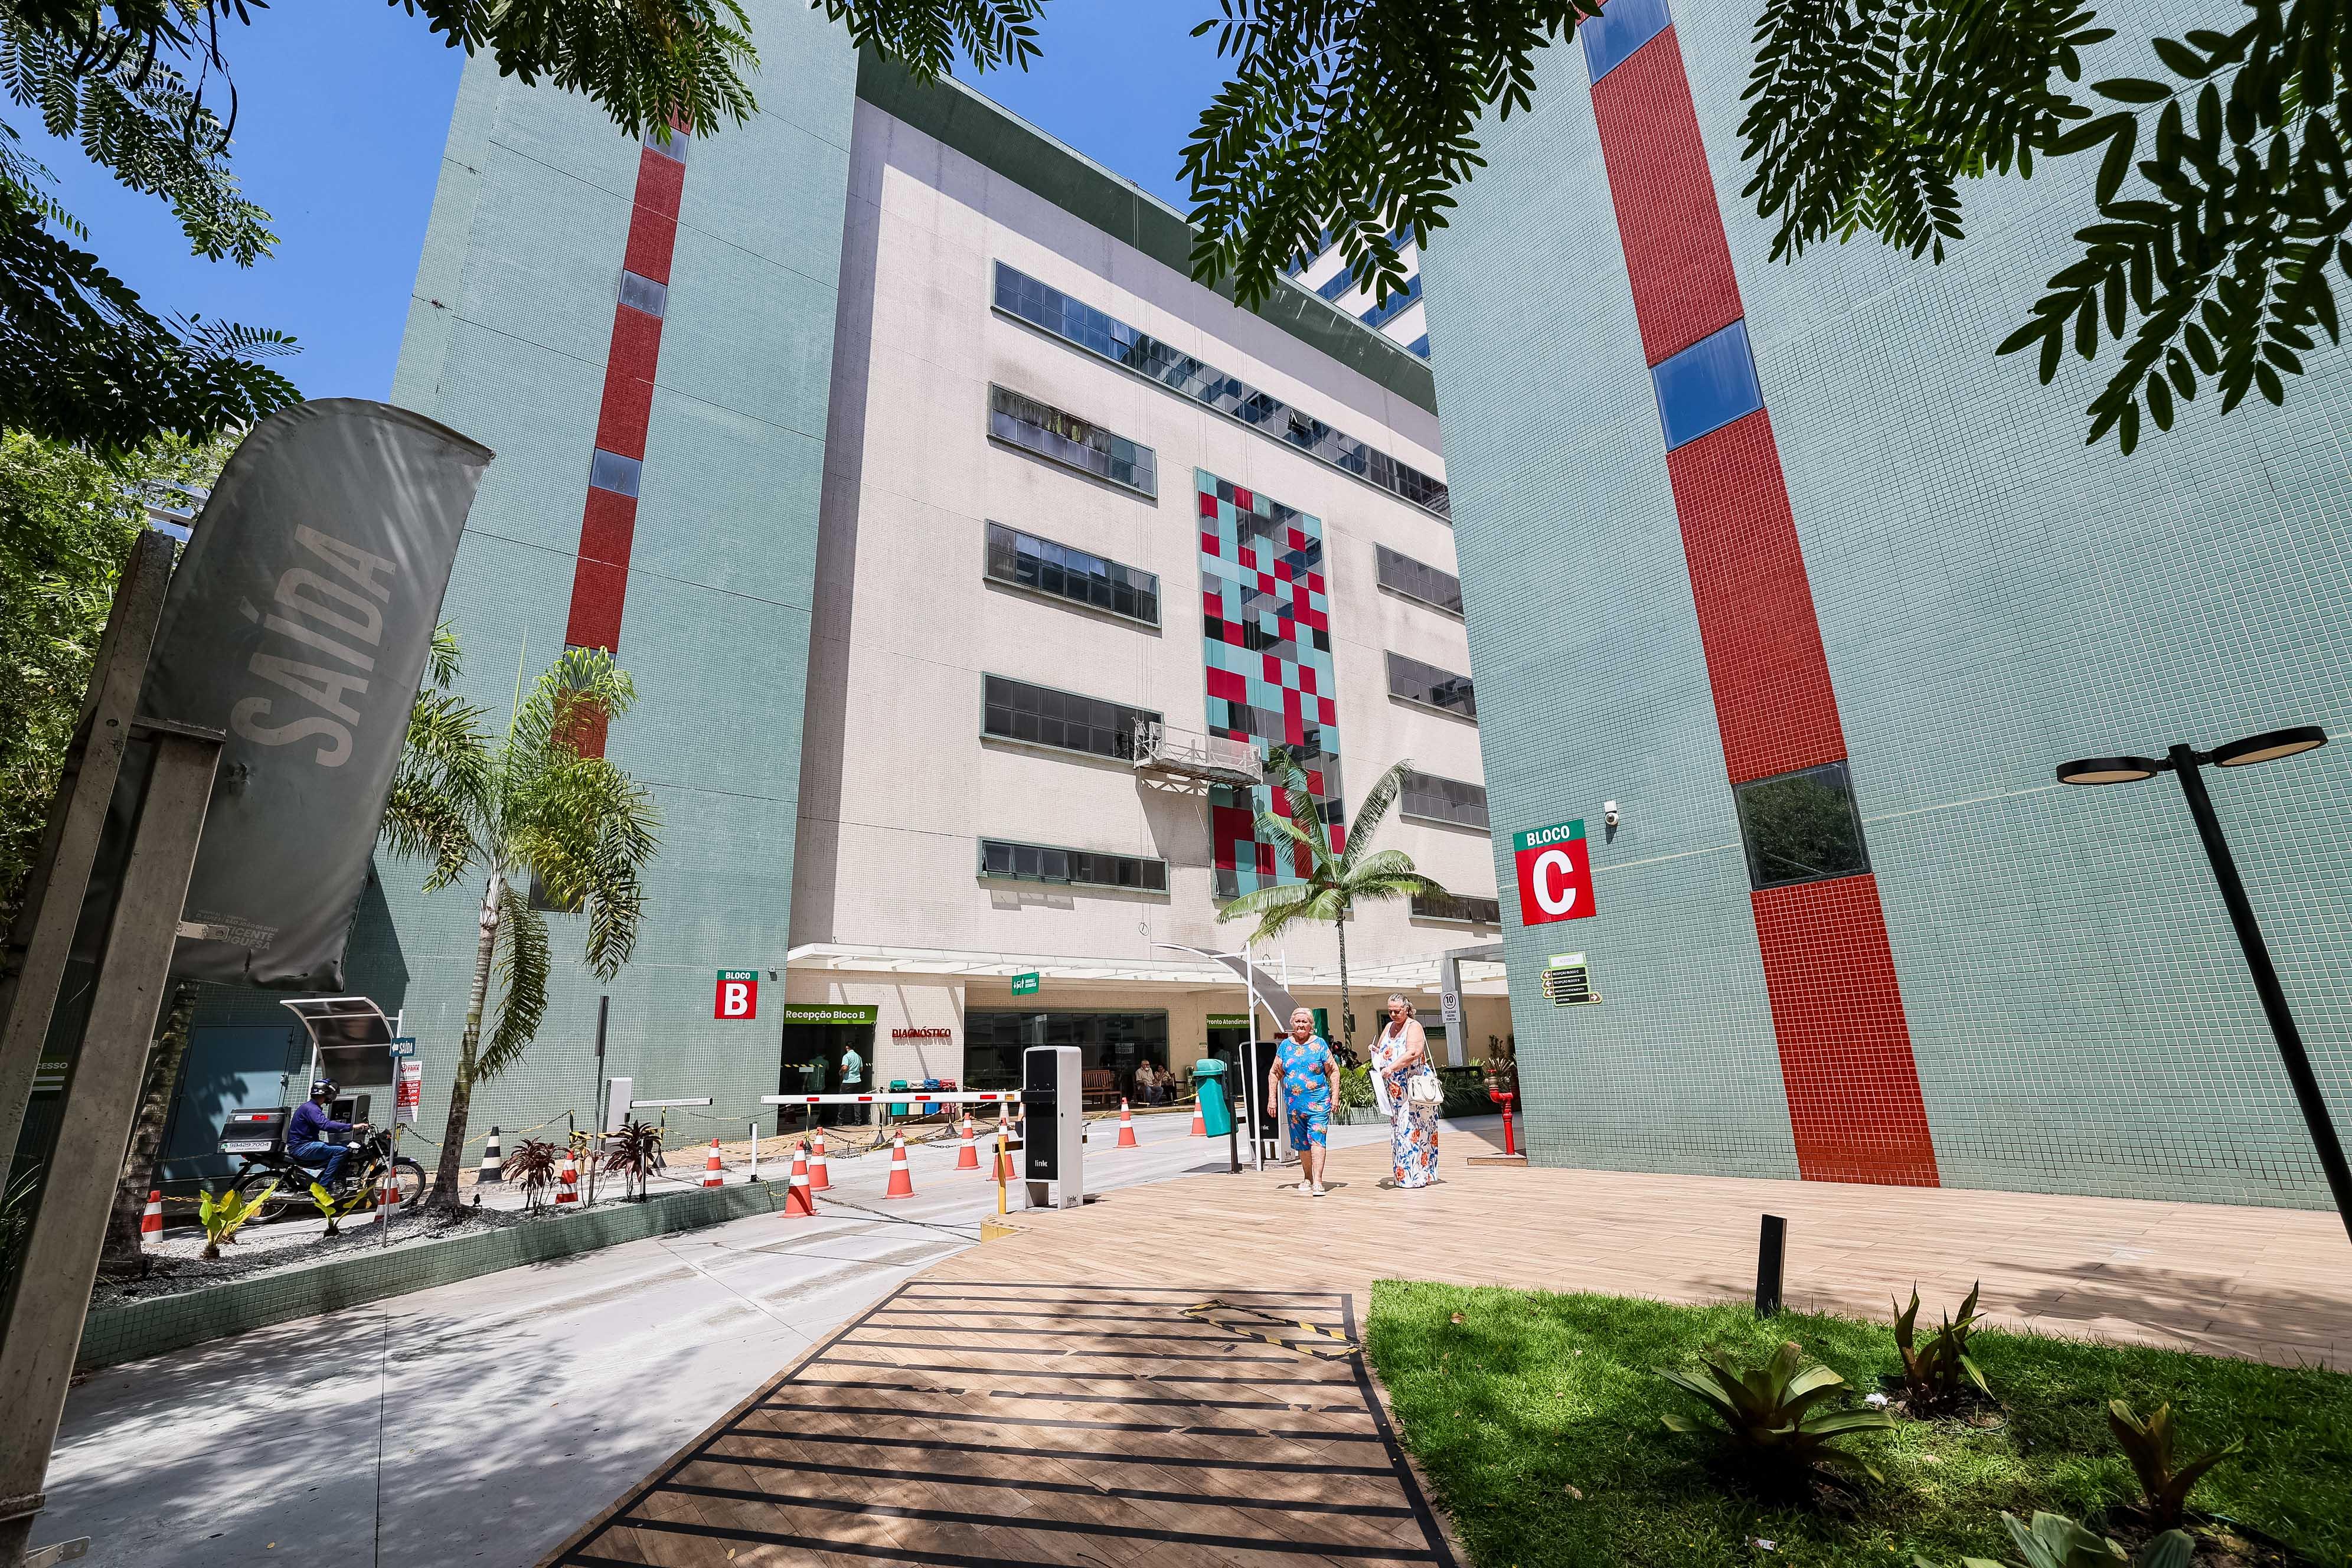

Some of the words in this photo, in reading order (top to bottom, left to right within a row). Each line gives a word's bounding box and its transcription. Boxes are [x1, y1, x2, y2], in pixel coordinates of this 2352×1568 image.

[231, 524, 397, 767] SAÍDA
[1526, 825, 1570, 847] BLOCO
[1533, 850, 1577, 915] C
[724, 984, 748, 1015] B
[786, 1011, 831, 1021] Recepção
[833, 1011, 858, 1019] Bloco
[892, 1026, 951, 1037] DIAGNÓSTICO
[399, 1041, 413, 1054] SAÍDA
